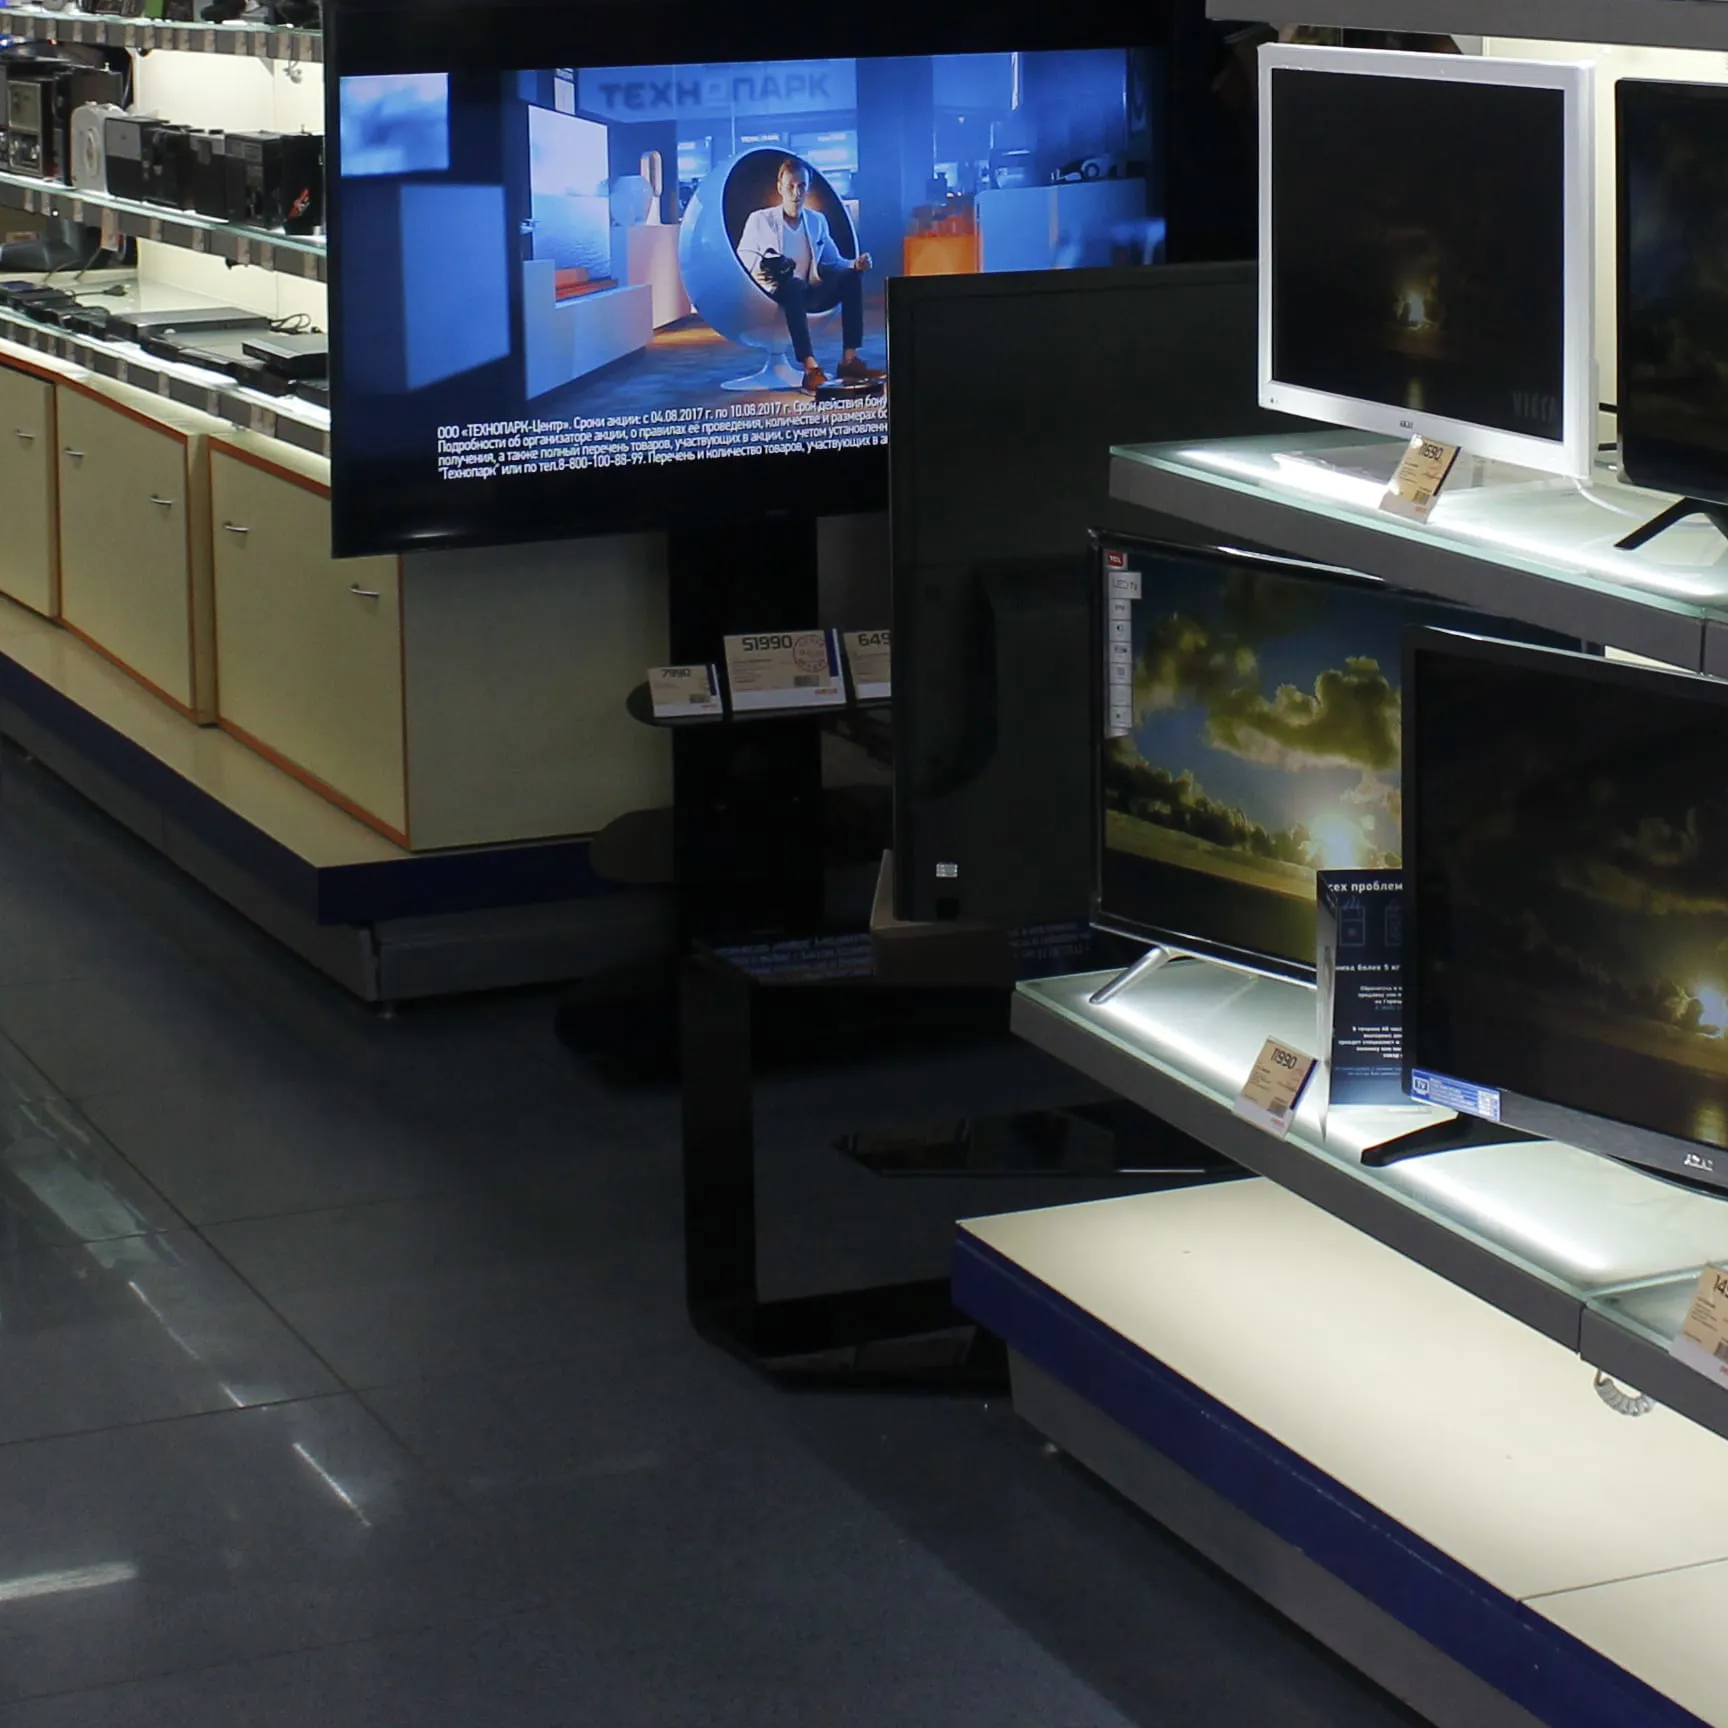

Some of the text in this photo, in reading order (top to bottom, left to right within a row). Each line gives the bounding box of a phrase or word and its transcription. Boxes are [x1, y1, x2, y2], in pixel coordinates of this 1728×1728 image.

[573, 416, 605, 429] Сроки
[715, 408, 728, 419] по
[793, 400, 816, 413] Срок
[438, 438, 507, 454] Подробности
[508, 435, 521, 448] об
[523, 430, 593, 449] организаторе
[640, 425, 686, 440] правилах
[765, 415, 821, 428] количестве
[831, 410, 876, 424] размерах
[506, 449, 538, 460] также
[540, 444, 580, 459] полный
[583, 442, 629, 456] перечень
[675, 433, 740, 450] участвующих
[502, 464, 522, 475] или
[524, 462, 537, 473] по
[648, 450, 695, 465] Перечень
[706, 445, 762, 459] количество
[807, 436, 870, 453] участвующих
[743, 636, 792, 651] 51990
